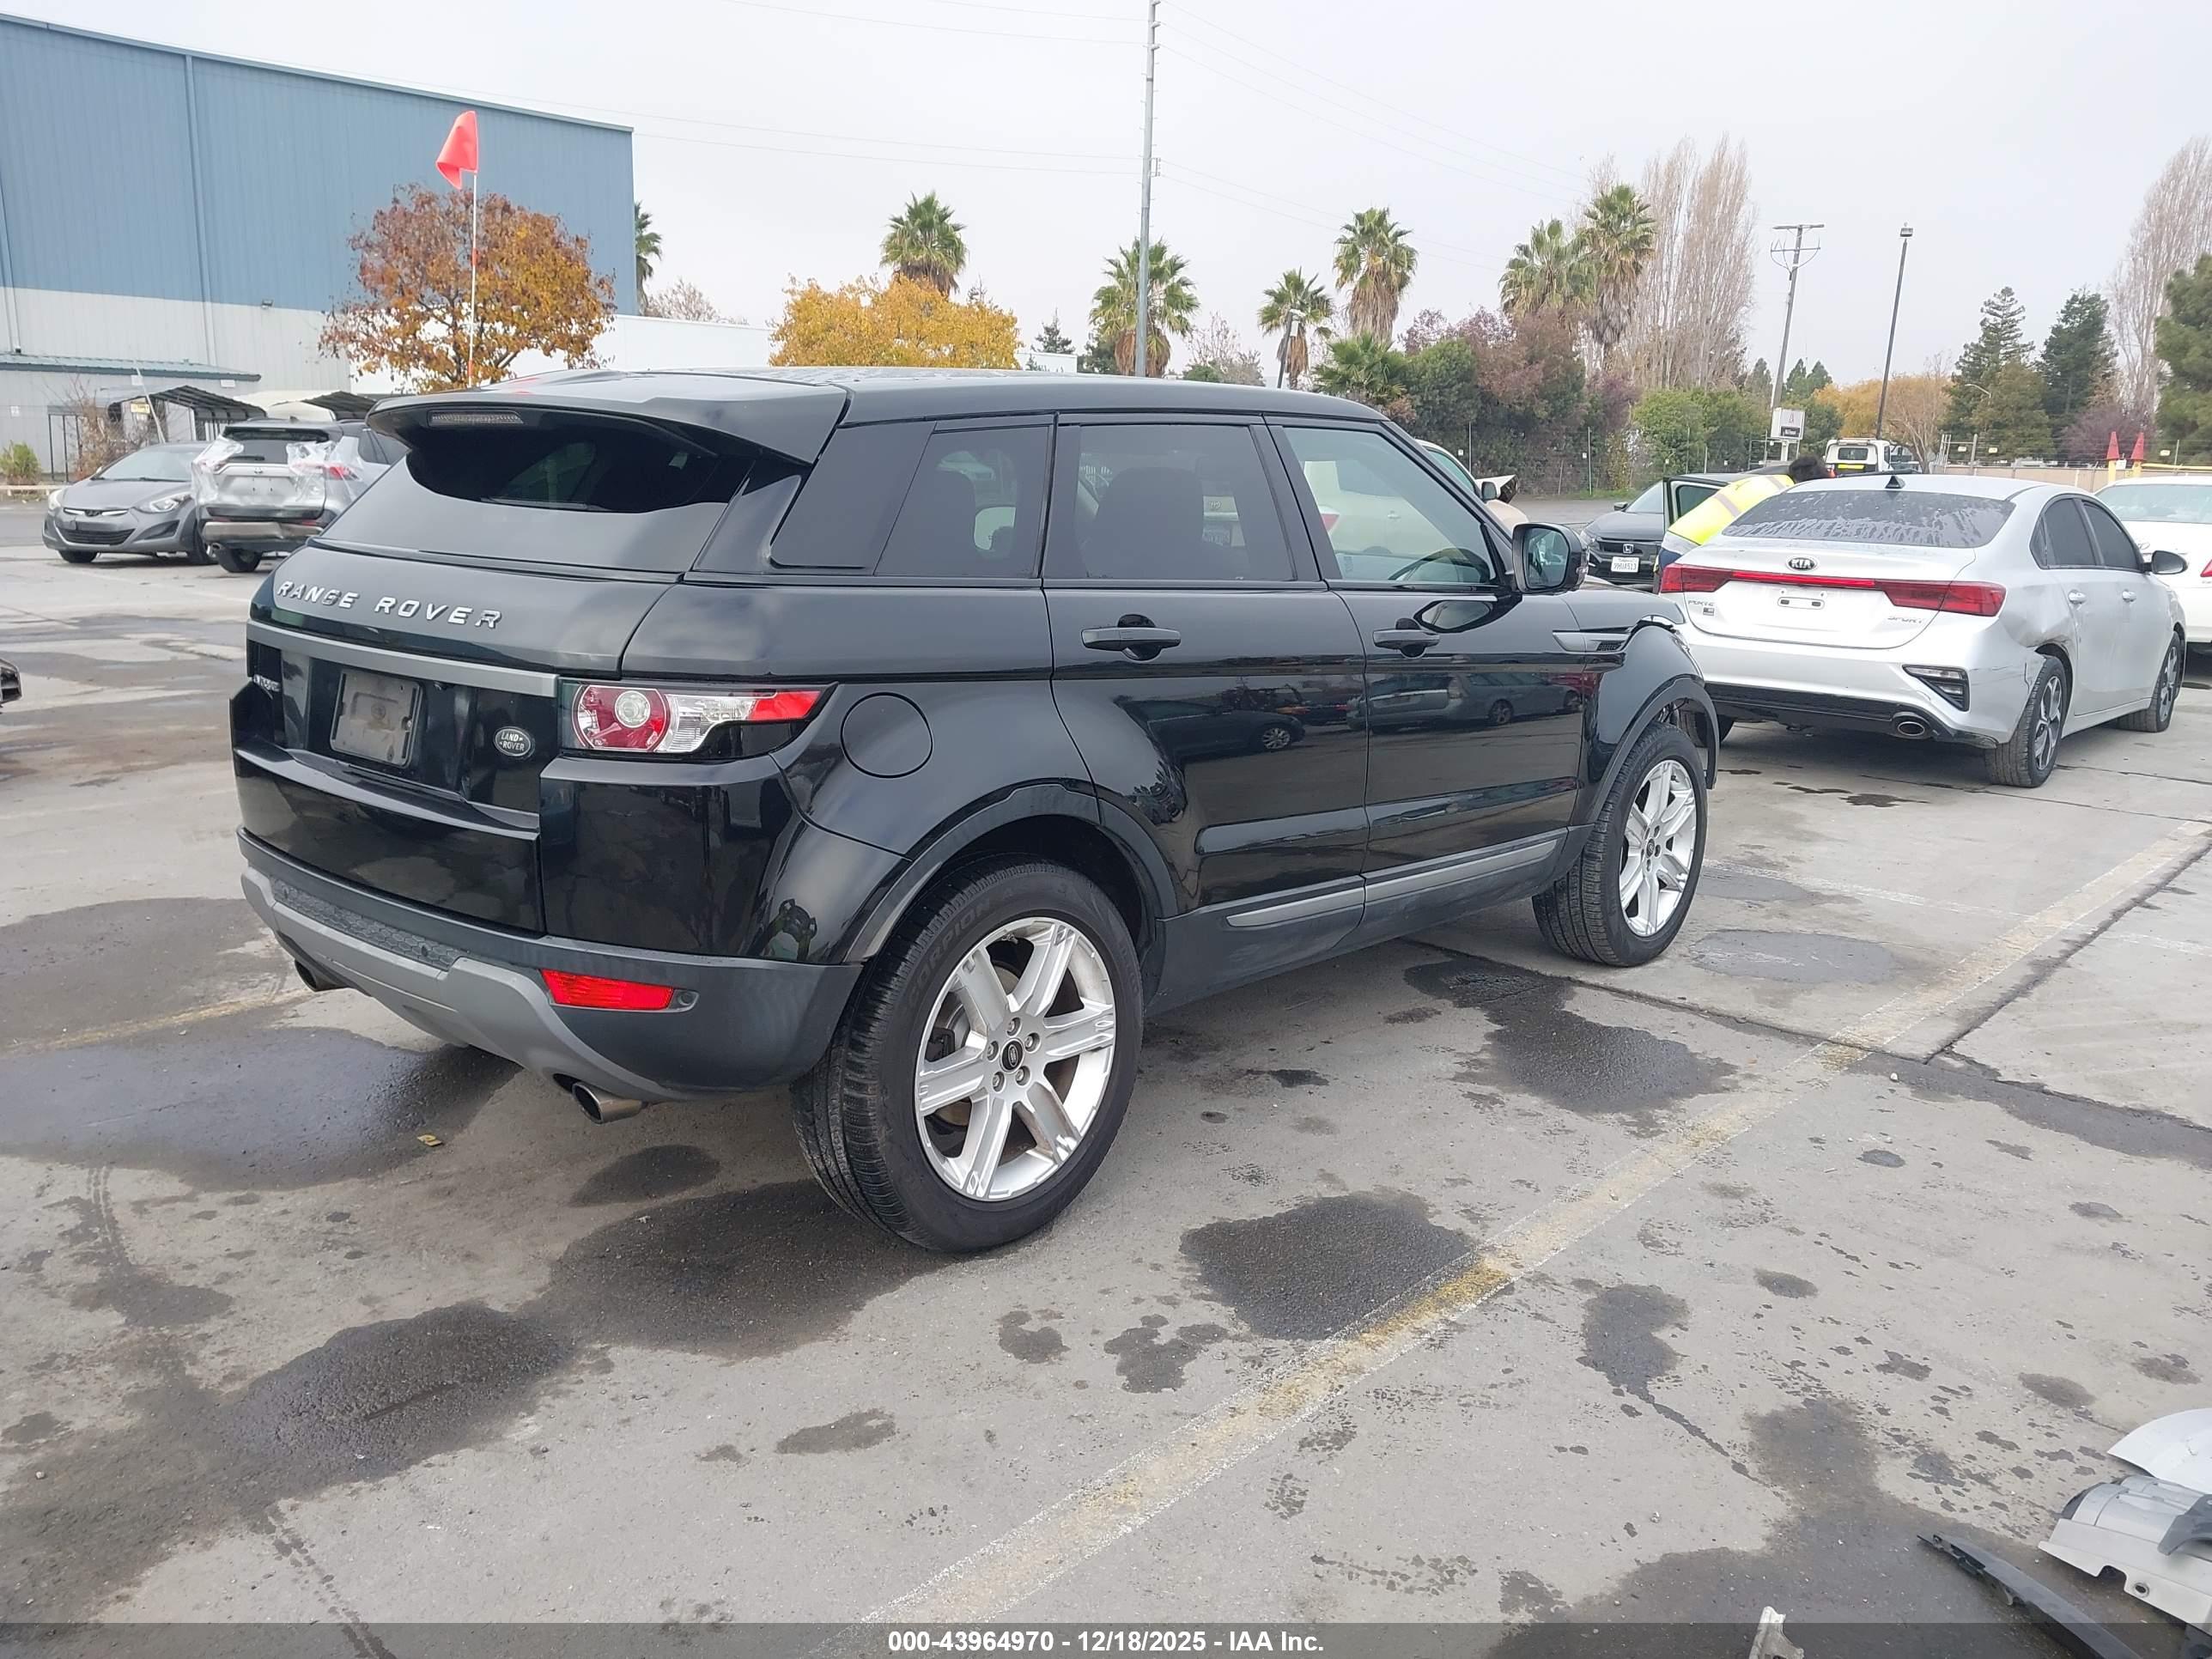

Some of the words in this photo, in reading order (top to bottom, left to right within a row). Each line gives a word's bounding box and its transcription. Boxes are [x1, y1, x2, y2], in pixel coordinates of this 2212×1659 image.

[1791, 559, 1812, 568] KIA
[276, 580, 359, 609] RANGE
[374, 597, 501, 629] ROVER
